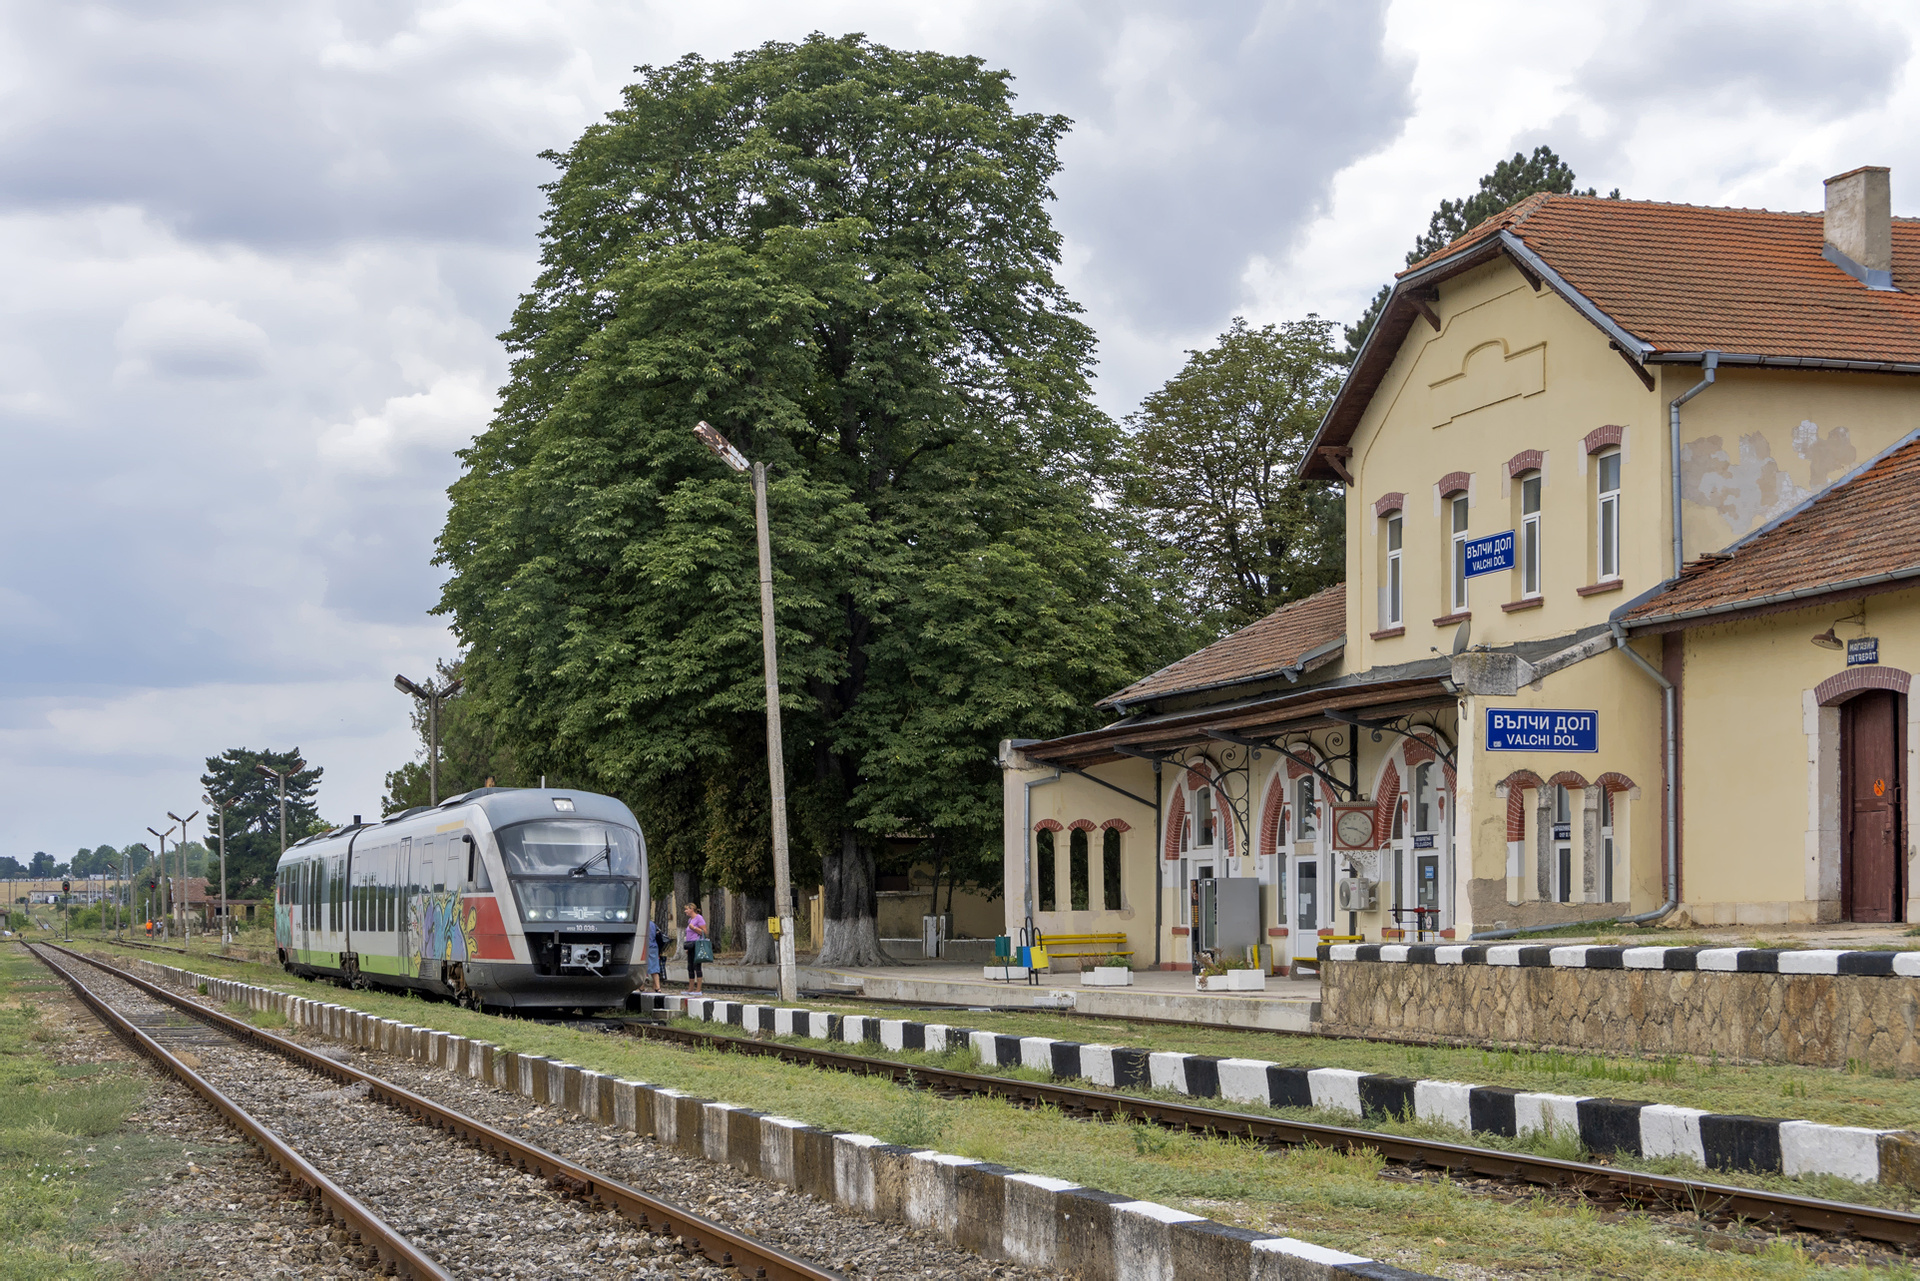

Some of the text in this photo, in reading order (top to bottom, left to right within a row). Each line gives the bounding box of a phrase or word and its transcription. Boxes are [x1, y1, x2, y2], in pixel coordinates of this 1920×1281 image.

[1467, 537, 1511, 559] ВЪЛЧИ ДОЛ
[1472, 555, 1505, 571] VALCHI DOL
[1494, 715, 1590, 734] ВЪЛЧИ ДОЛ
[1506, 734, 1550, 746] VALCHI
[1553, 735, 1578, 746] DOL
